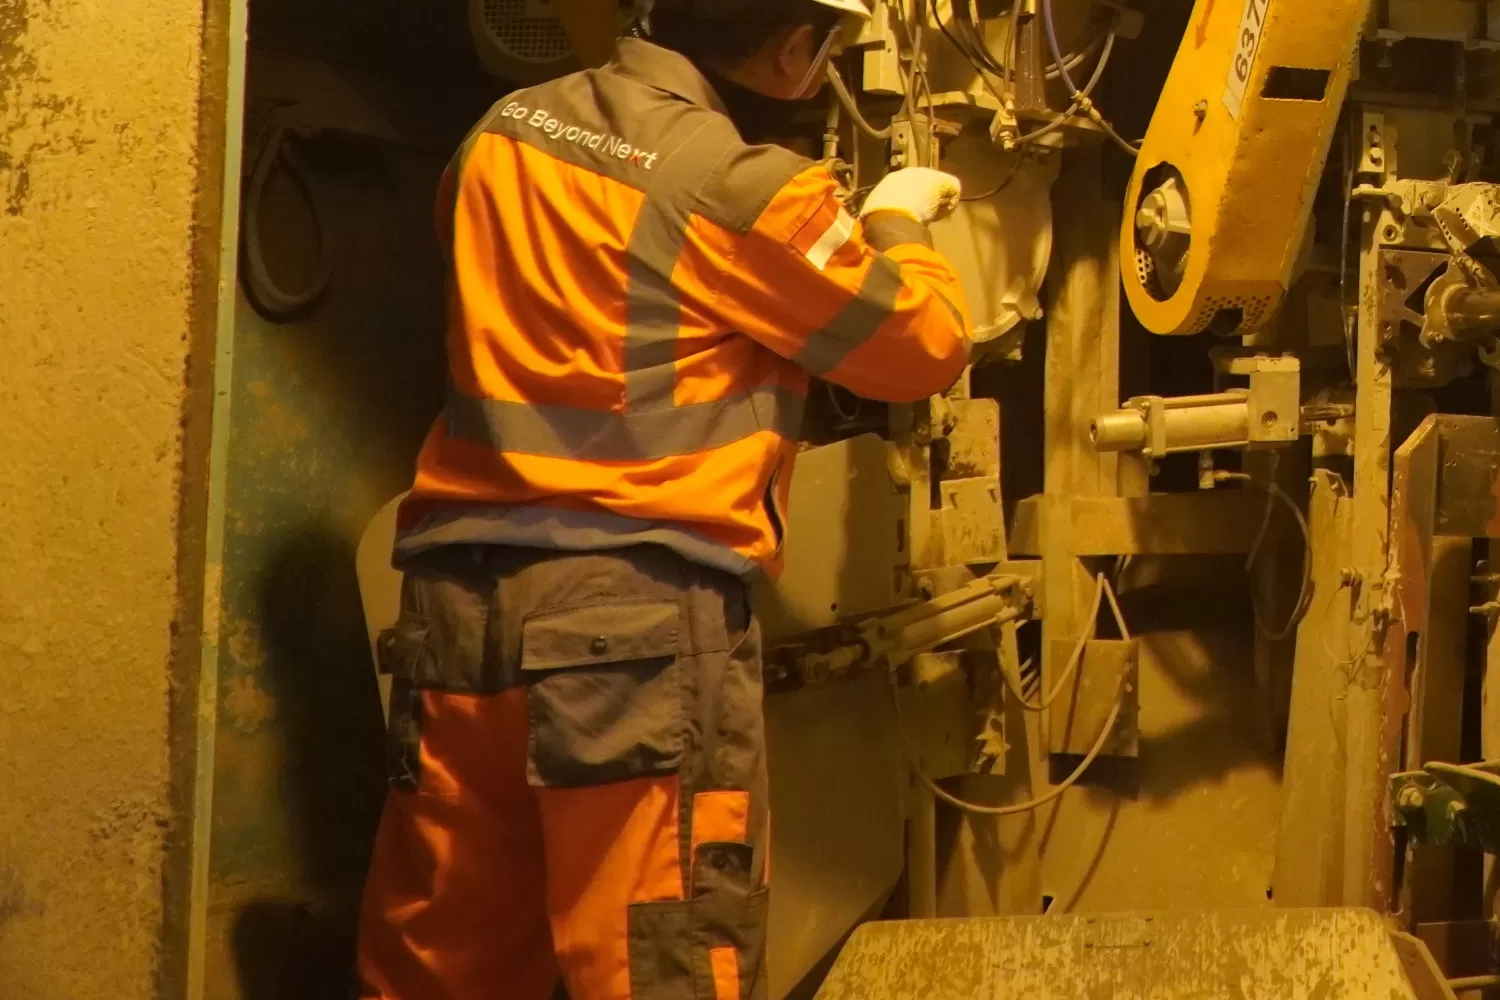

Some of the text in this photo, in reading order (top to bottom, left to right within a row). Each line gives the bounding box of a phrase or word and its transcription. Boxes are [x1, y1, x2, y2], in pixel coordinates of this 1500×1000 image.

[501, 102, 657, 169] Go Beyond Next
